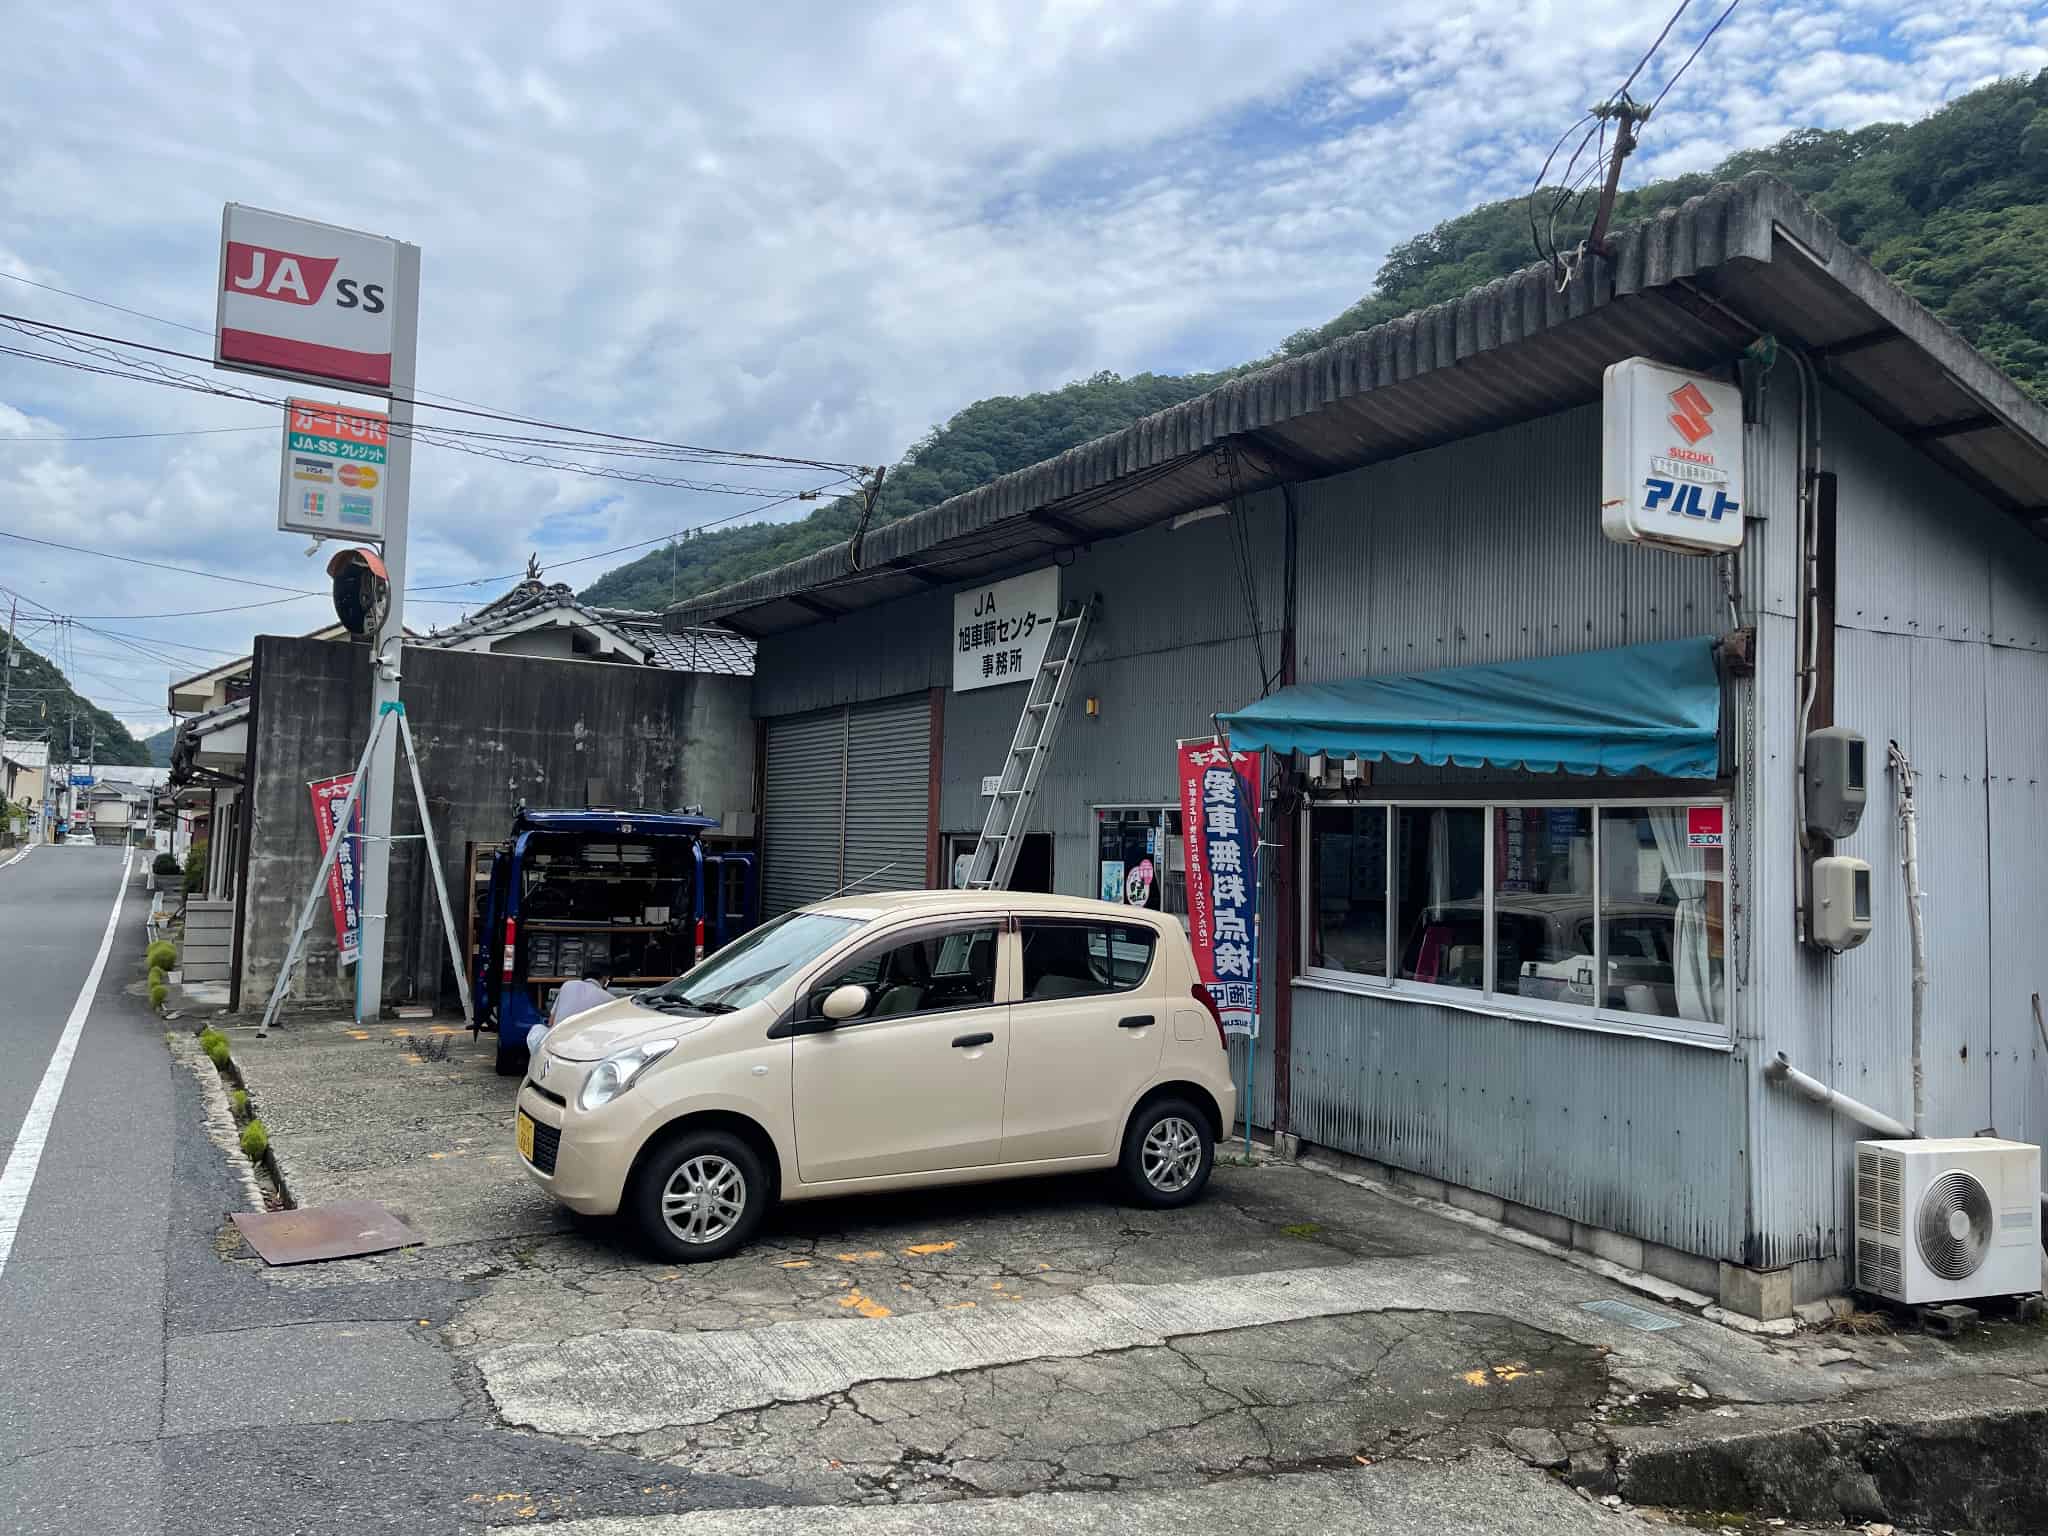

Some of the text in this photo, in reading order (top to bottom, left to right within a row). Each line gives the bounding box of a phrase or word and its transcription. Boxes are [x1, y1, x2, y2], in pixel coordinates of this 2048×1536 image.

[235, 252, 385, 314] JA SS
[341, 443, 384, 461] クレジット
[1667, 448, 1714, 464] SUZUKI
[1644, 478, 1740, 521] アルト
[974, 592, 996, 617] JA
[982, 648, 1022, 678] 事務所
